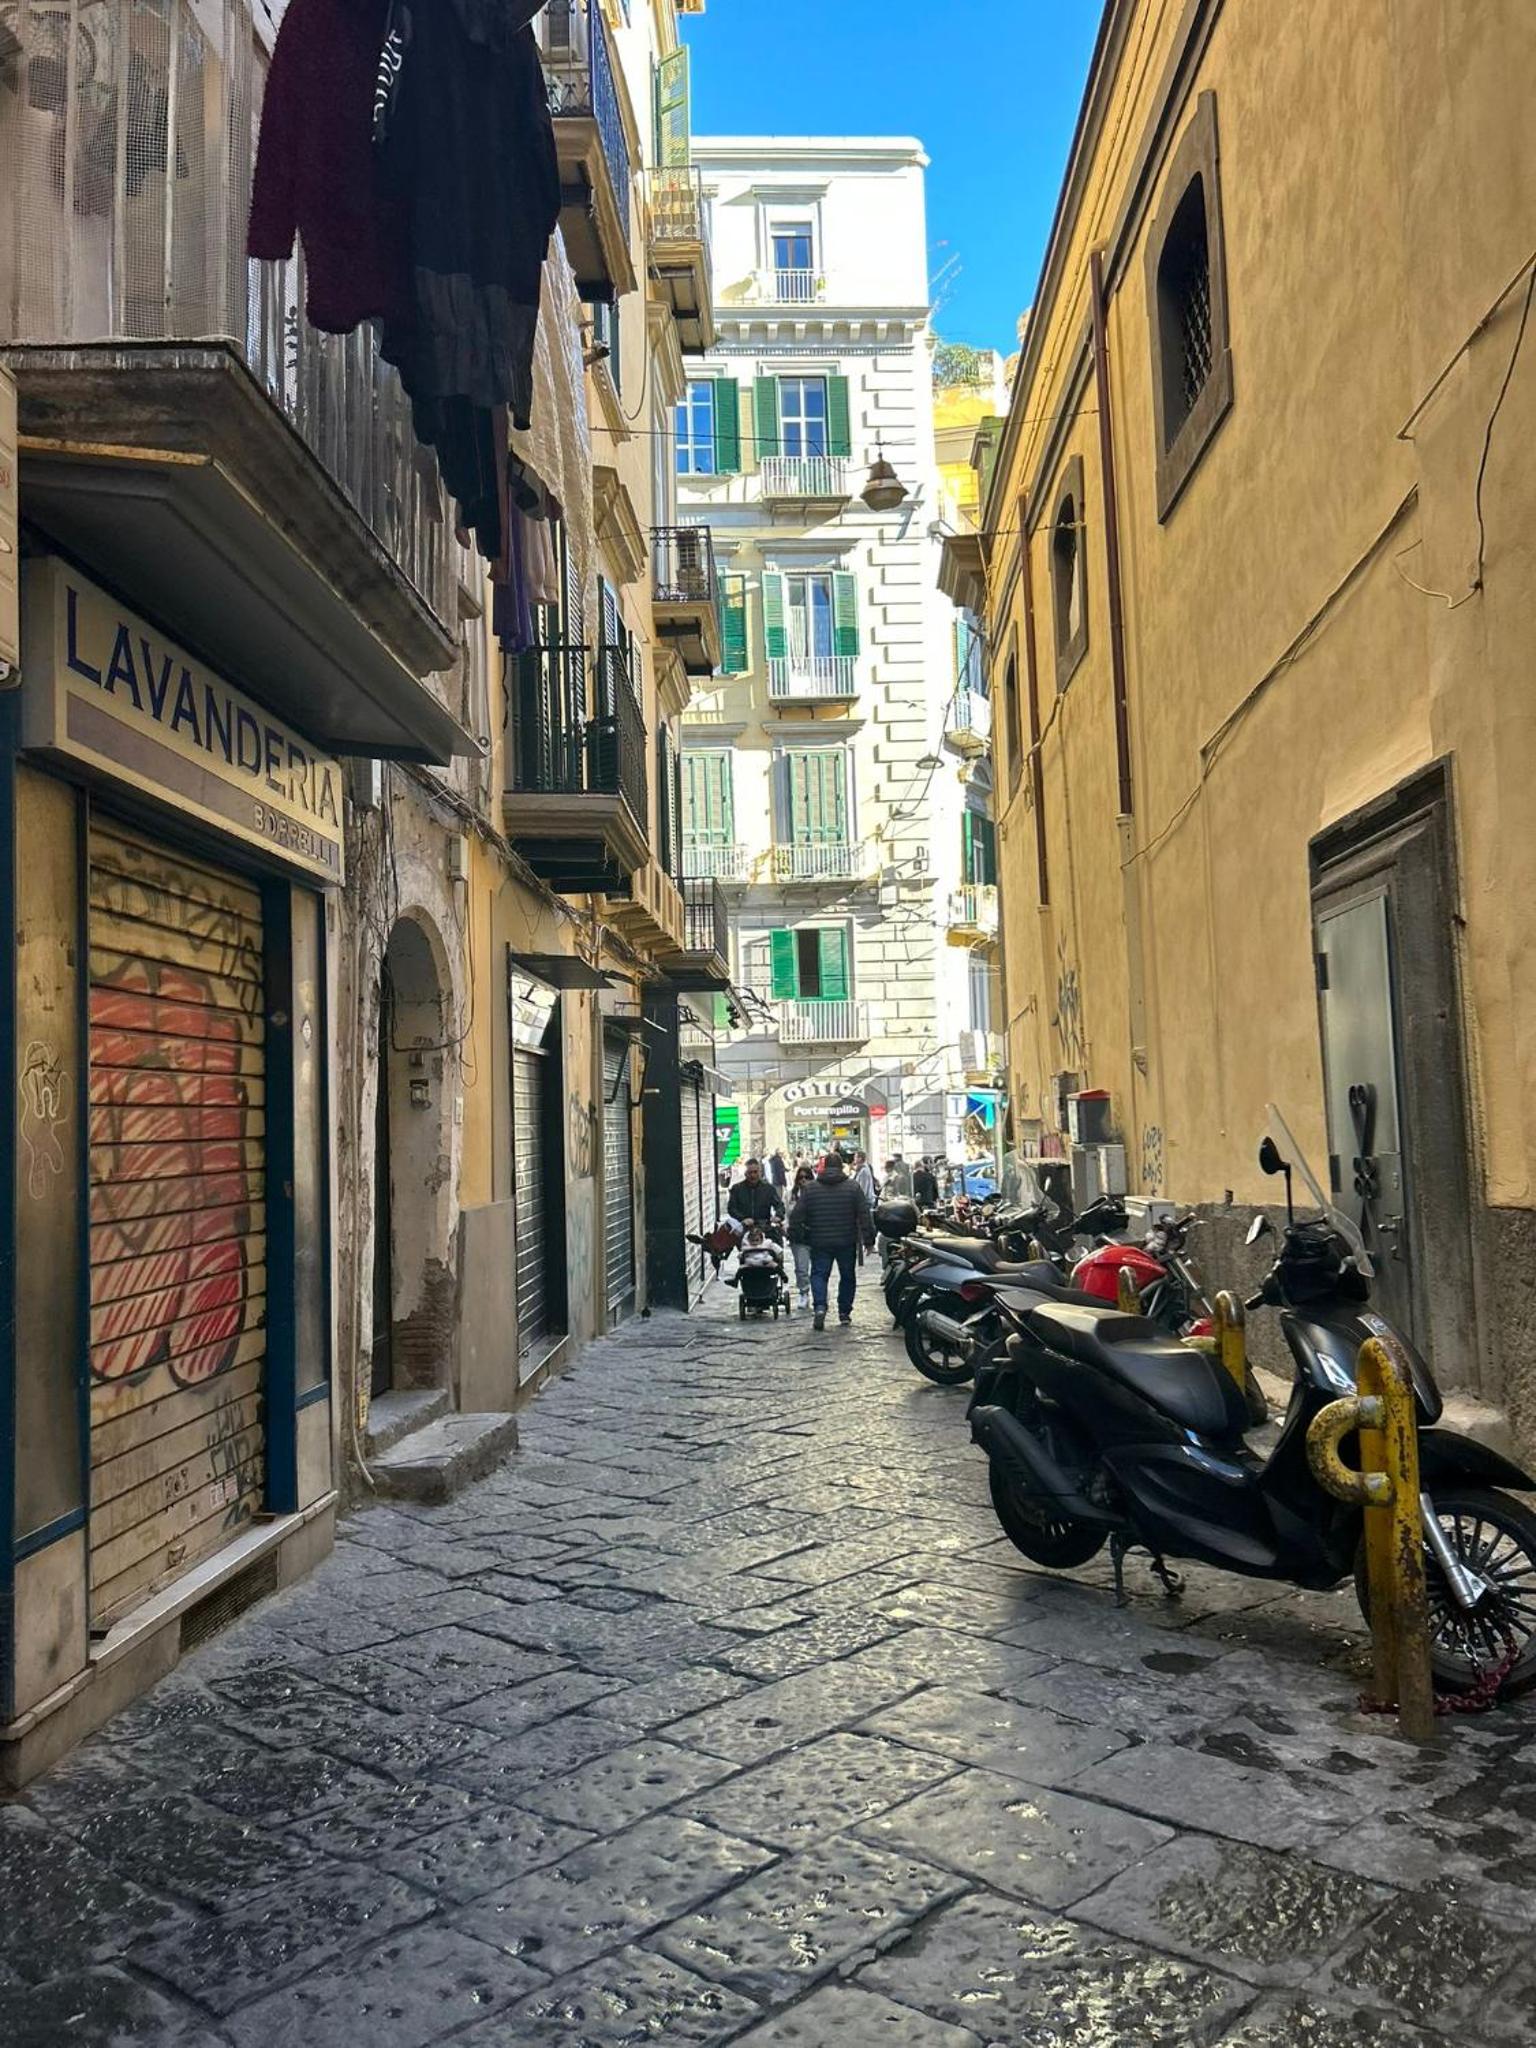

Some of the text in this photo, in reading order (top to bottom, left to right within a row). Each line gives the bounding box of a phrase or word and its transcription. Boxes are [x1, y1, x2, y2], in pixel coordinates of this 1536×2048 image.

[66, 585, 339, 828] LAVANDERIA
[253, 804, 333, 867] BORRELLI
[784, 1080, 865, 1102] OTTICA
